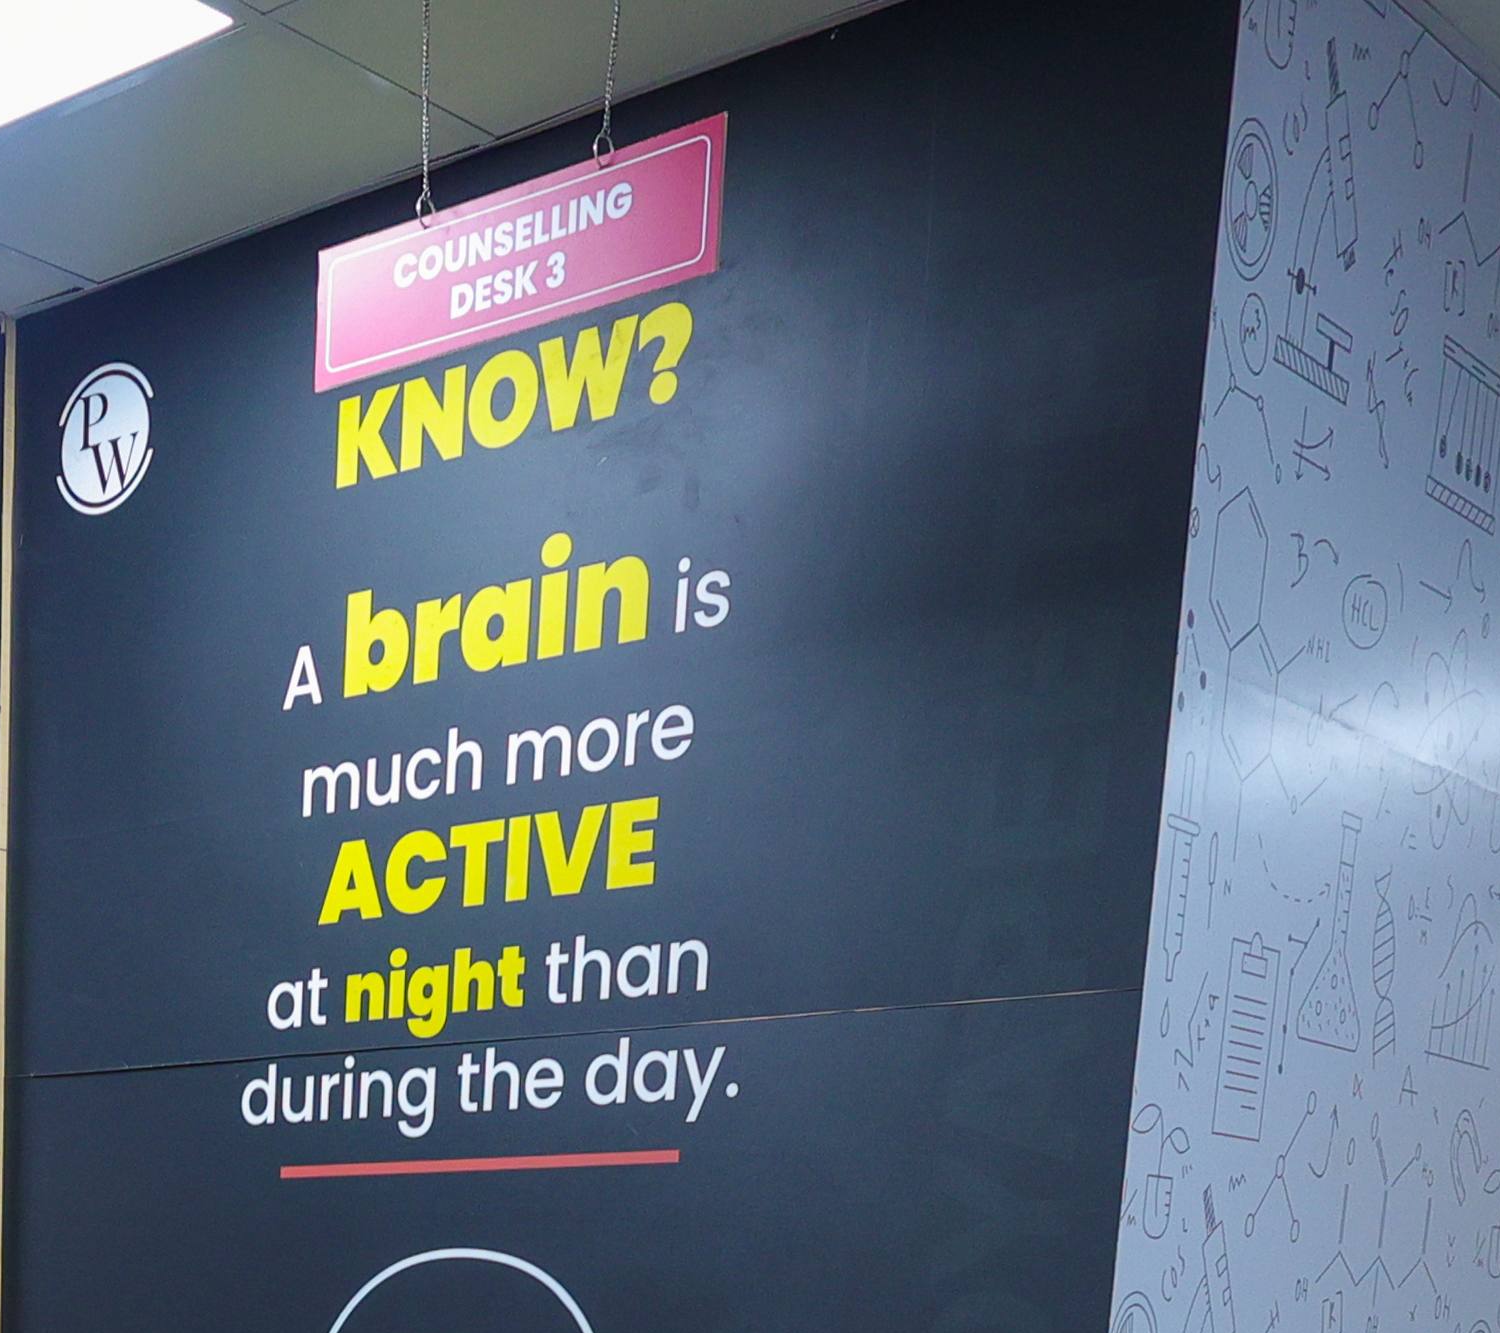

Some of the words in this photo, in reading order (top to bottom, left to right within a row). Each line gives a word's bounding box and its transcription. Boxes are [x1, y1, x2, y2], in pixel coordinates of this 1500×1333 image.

[393, 182, 634, 289] COUNSELLING
[449, 269, 539, 321] DESK
[547, 253, 566, 289] 3
[336, 301, 694, 490] KNOW?
[281, 646, 323, 711] A
[342, 532, 649, 699] brain
[674, 558, 731, 633] is
[302, 728, 483, 818] much
[504, 703, 695, 786] more
[317, 797, 659, 925] ACTIVE
[267, 969, 328, 1030] at
[344, 946, 525, 1039] night
[545, 934, 709, 1005] than
[241, 1056, 438, 1139] during
[458, 1048, 564, 1112] the
[584, 1038, 741, 1123] day.
